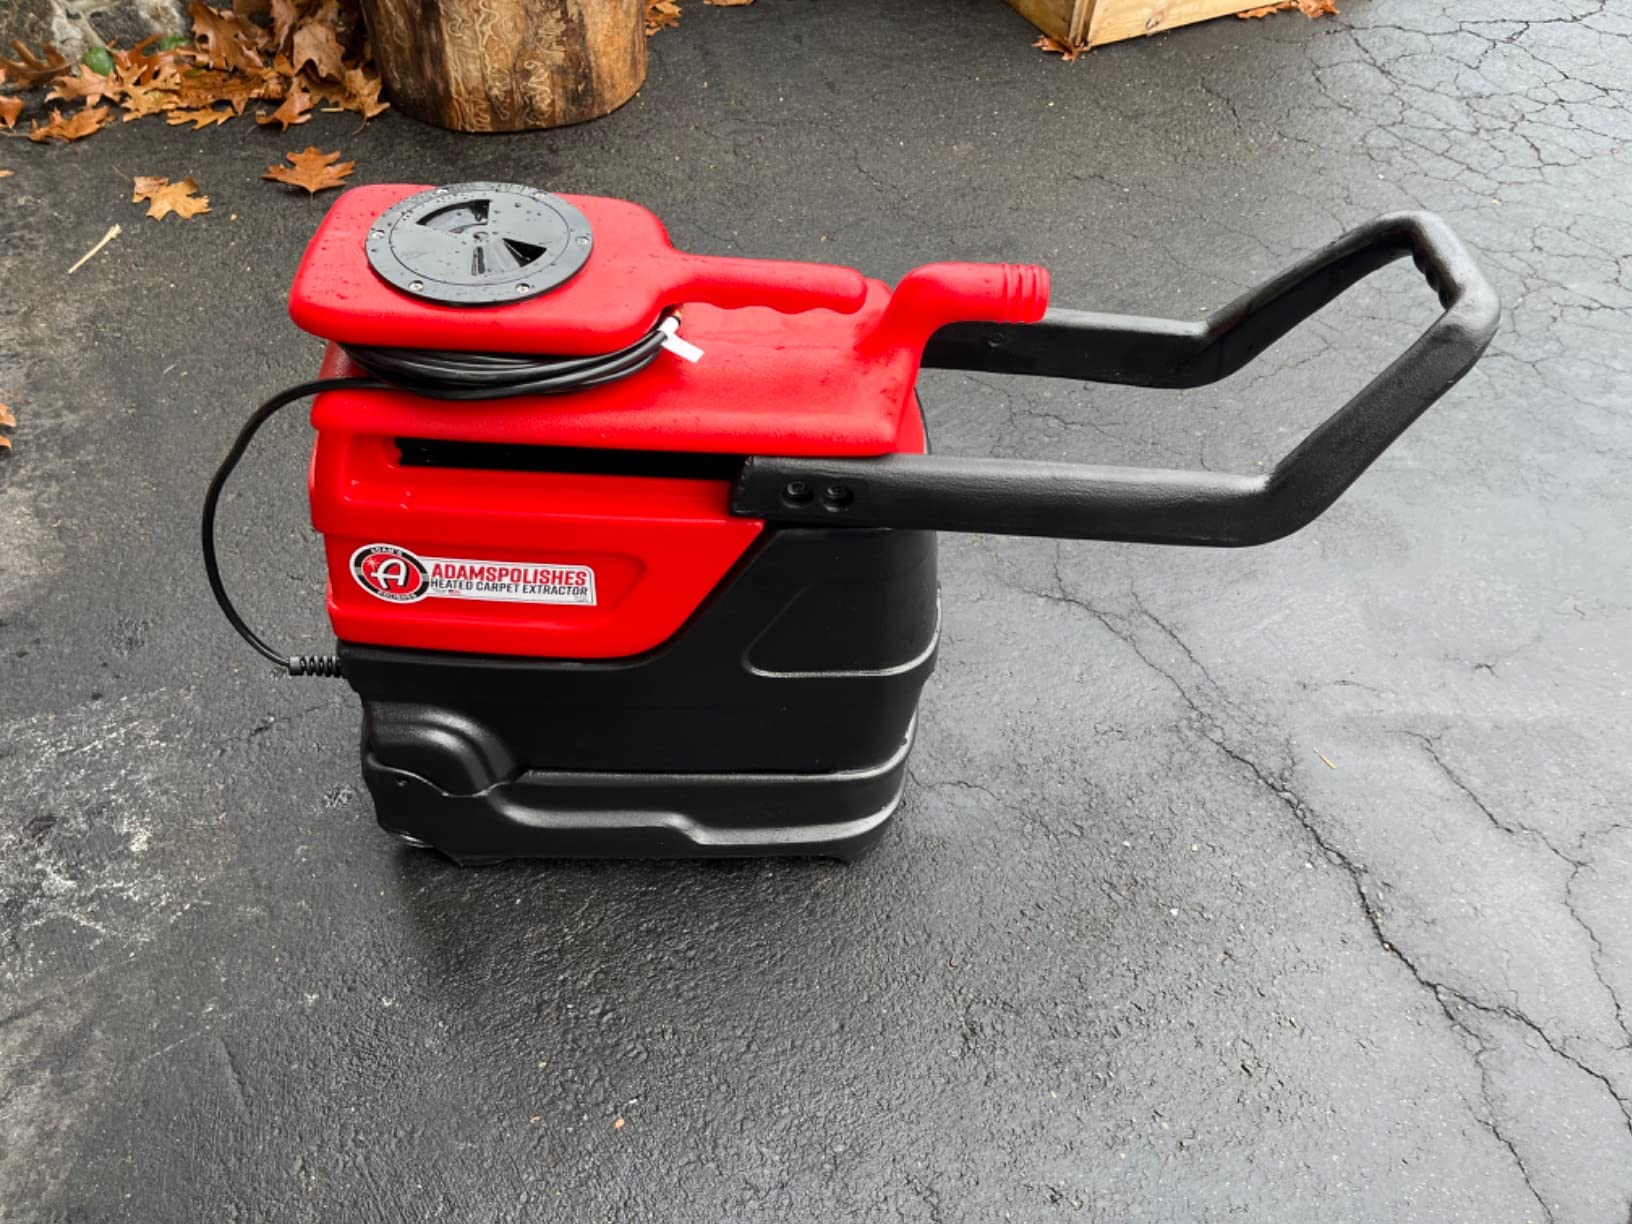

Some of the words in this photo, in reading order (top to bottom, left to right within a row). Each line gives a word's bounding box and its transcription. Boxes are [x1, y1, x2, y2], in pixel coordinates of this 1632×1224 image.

[370, 558, 407, 589] A
[432, 563, 587, 586] ADAMSPOLISHES
[430, 578, 474, 591] HEATED
[476, 581, 520, 593] CARPET
[522, 584, 588, 596] EXTRACTOR
